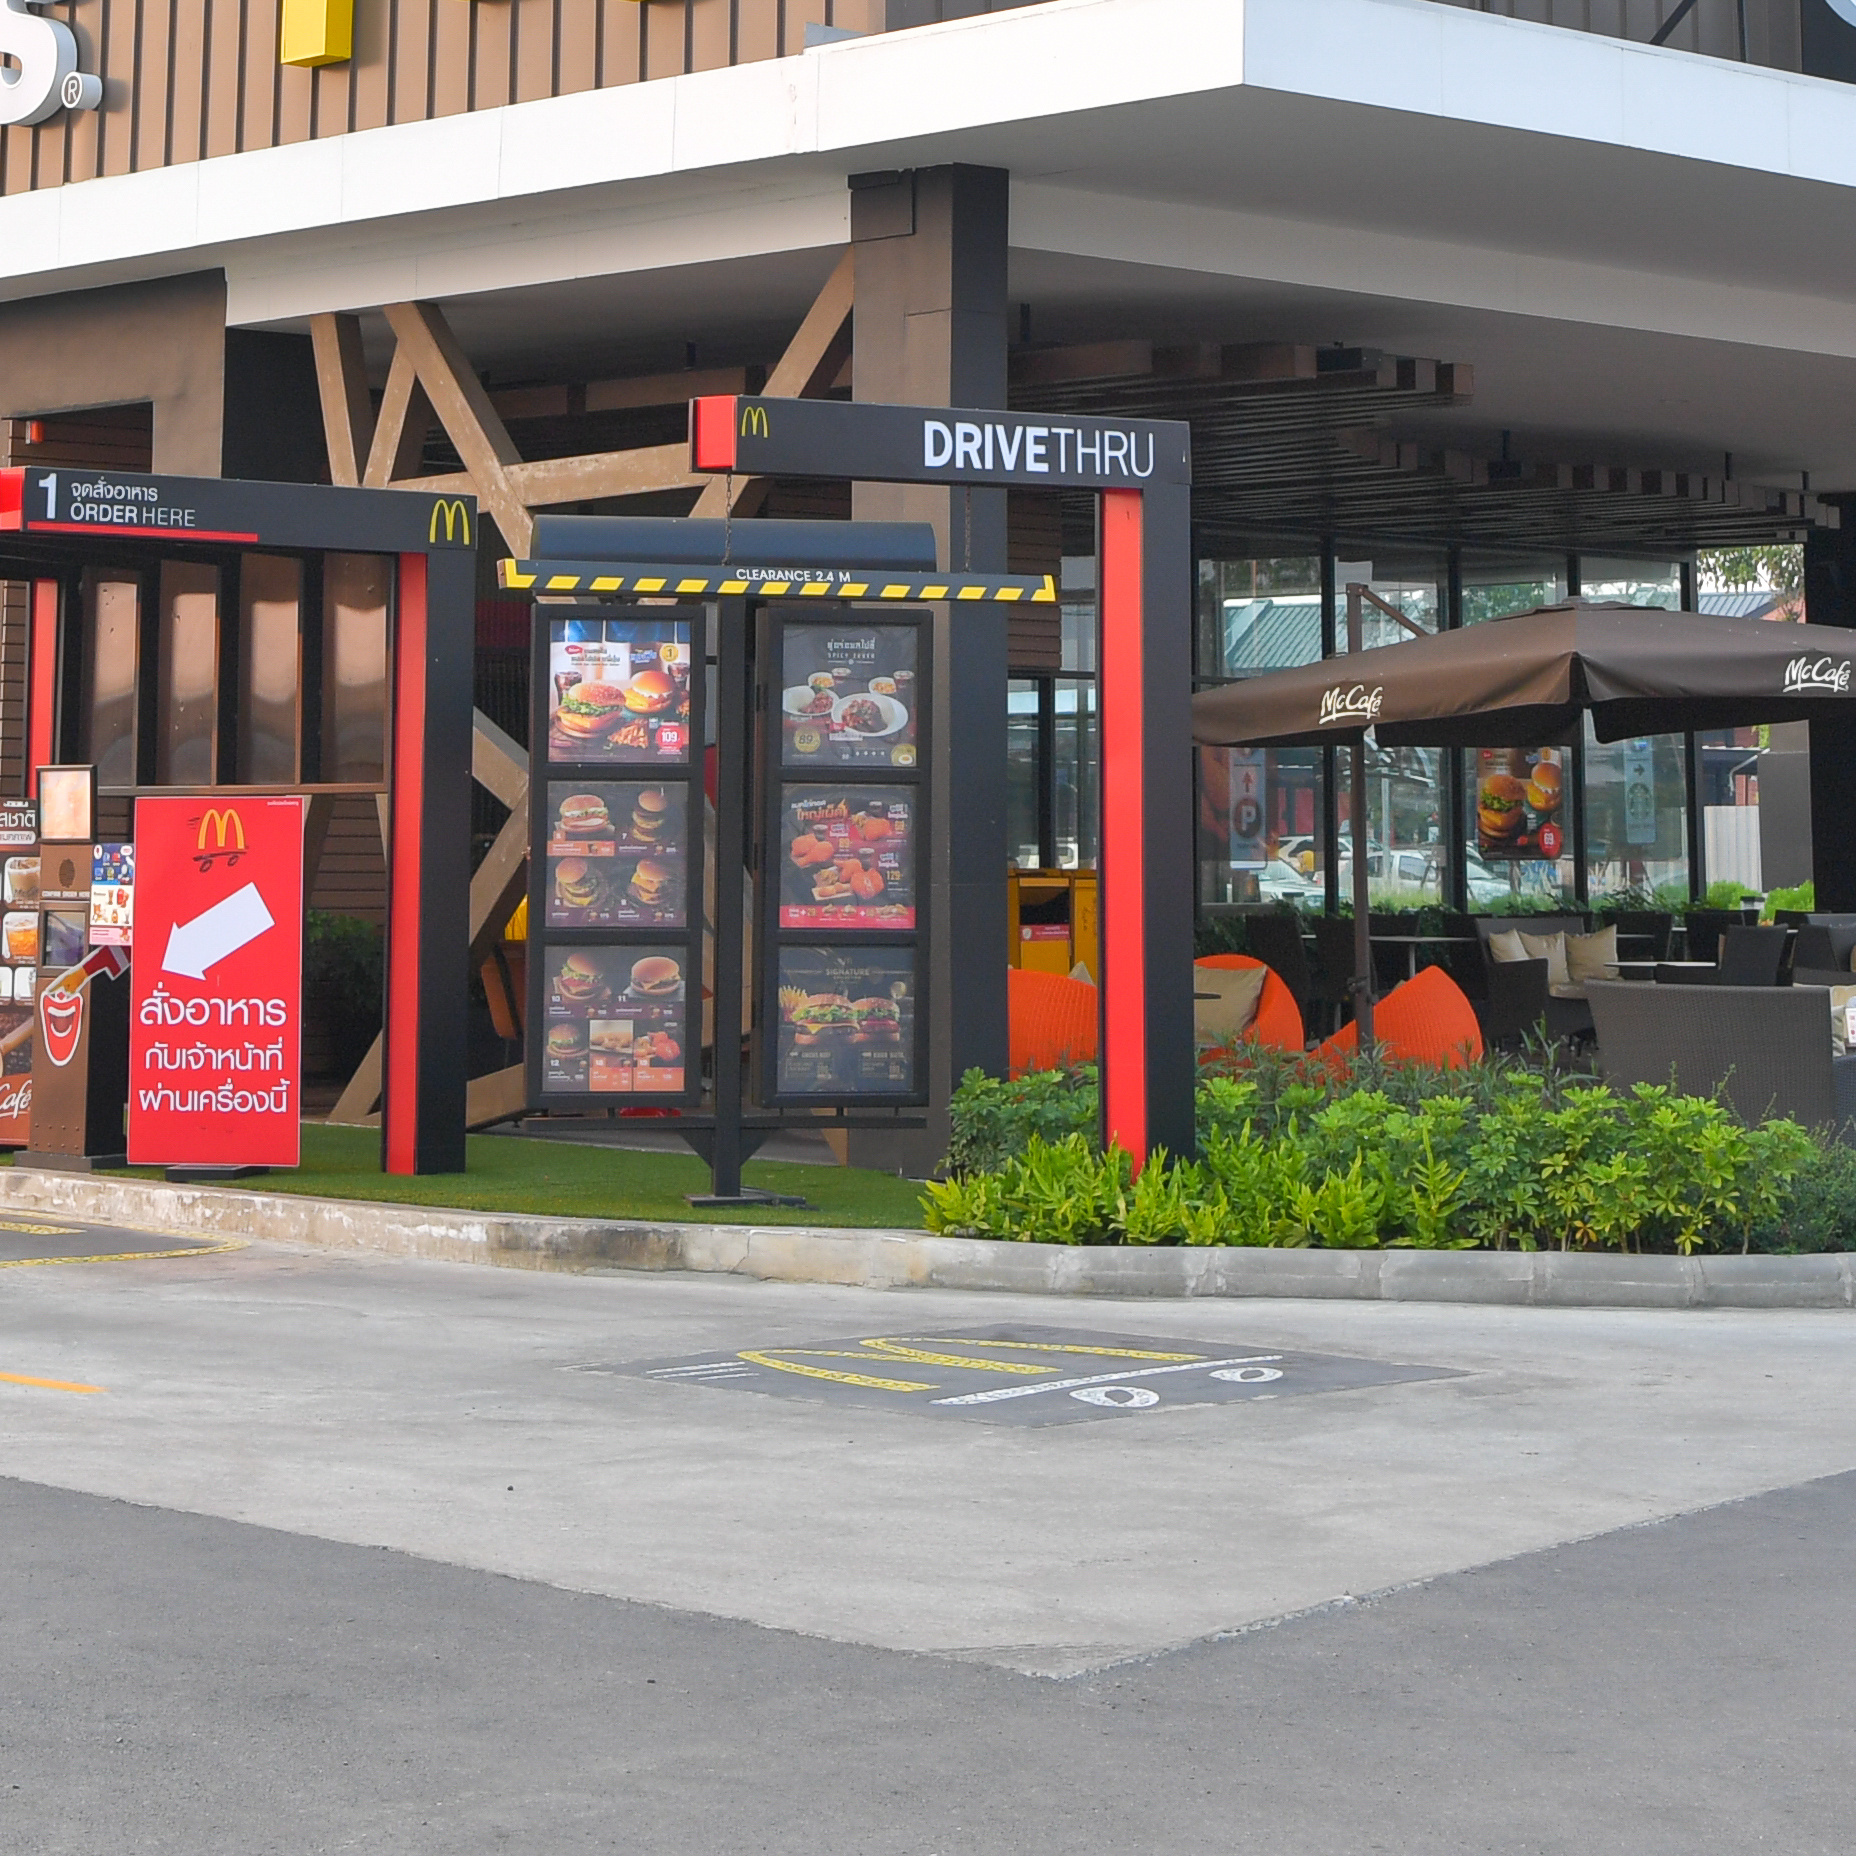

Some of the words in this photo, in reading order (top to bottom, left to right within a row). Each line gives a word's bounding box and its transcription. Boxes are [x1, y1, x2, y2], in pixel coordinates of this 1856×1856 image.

[38, 473, 58, 520] 1
[70, 476, 159, 503] จุดสั่งอาหาร
[70, 503, 138, 523] ORDER
[142, 507, 196, 527] HERE
[736, 568, 811, 582] CLEARANCE
[816, 570, 834, 582] 2.4
[838, 571, 851, 583] M
[1783, 656, 1851, 693] McCafé
[1319, 684, 1383, 724] McCafé
[798, 734, 814, 744] 89
[1241, 805, 1256, 831] P
[139, 982, 287, 1026] สั่งอาหาร
[145, 1036, 283, 1071] กับเจ้าหน้าที่
[138, 1078, 291, 1113] ผ่านเครื่องนี้
